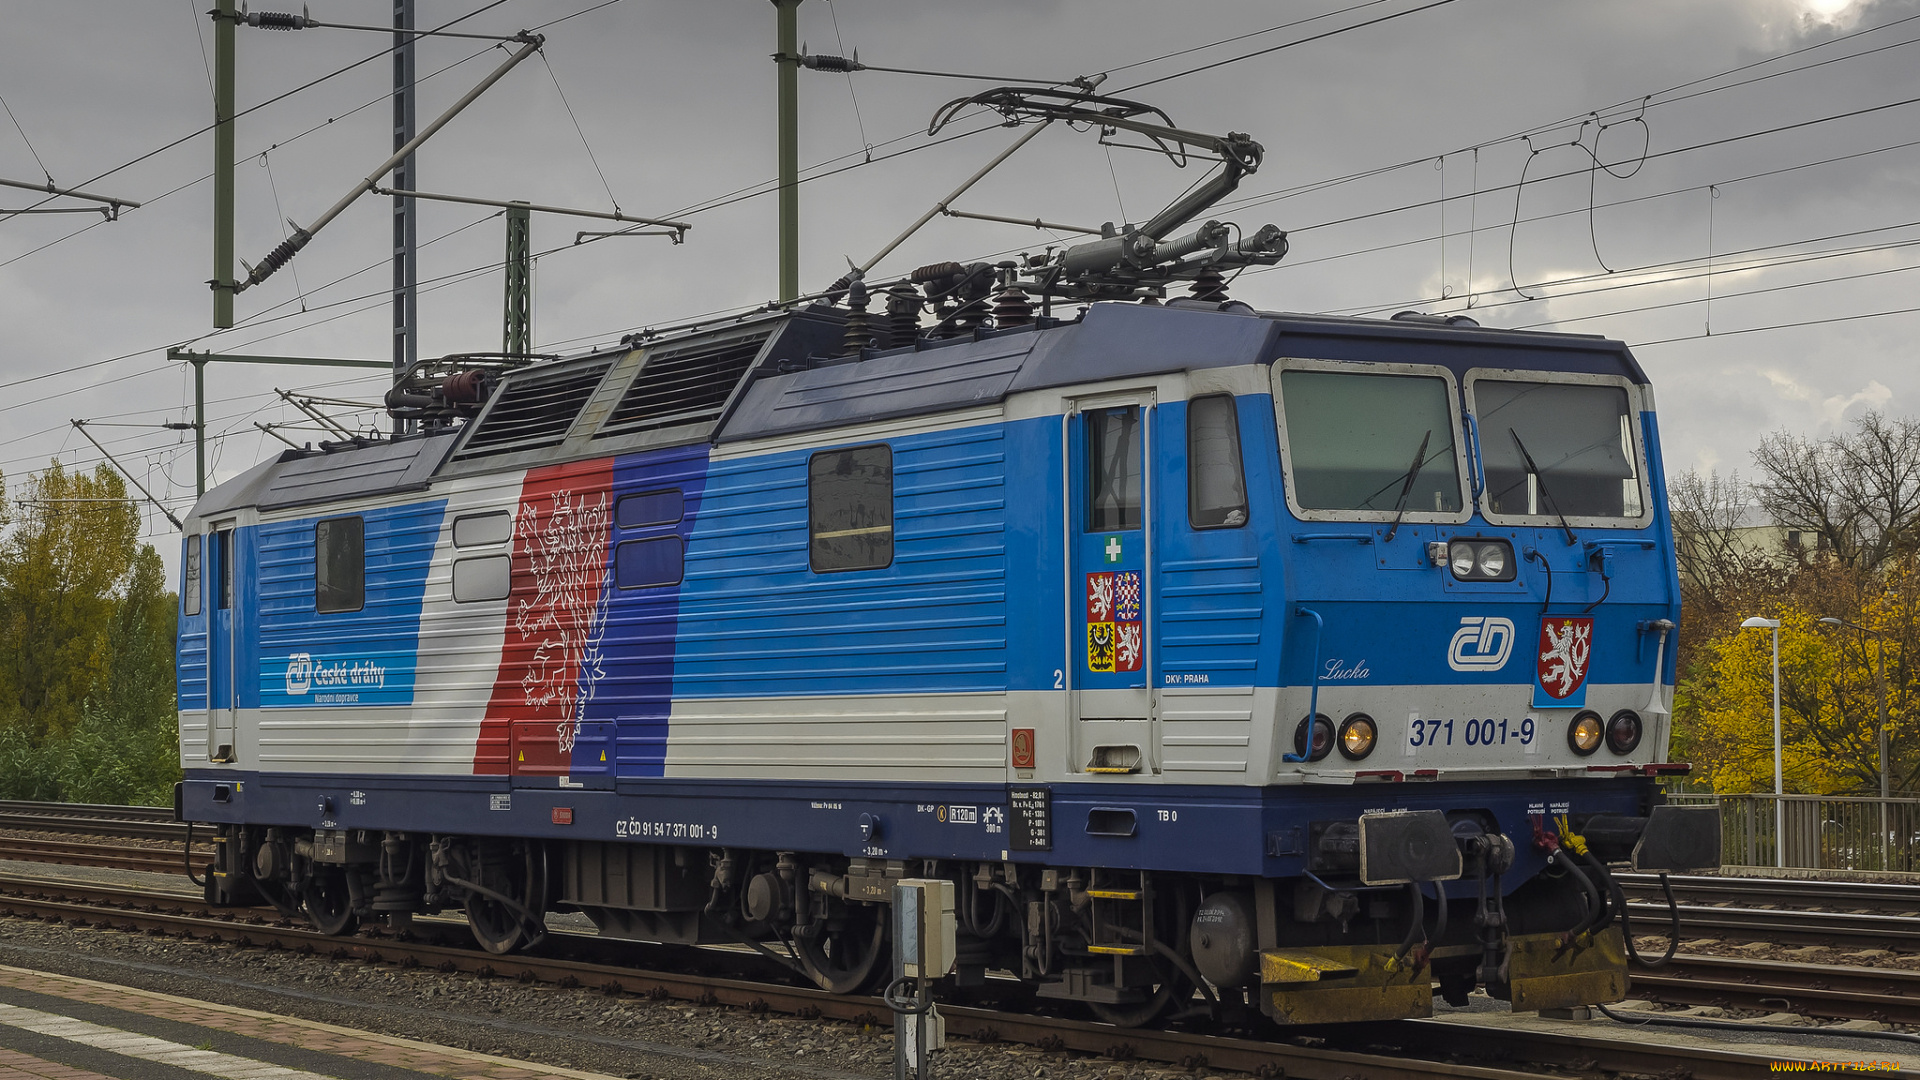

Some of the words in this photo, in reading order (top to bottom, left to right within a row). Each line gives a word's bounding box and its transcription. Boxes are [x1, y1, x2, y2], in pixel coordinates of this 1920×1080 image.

[313, 658, 348, 686] České
[349, 659, 386, 689] dráhy
[1053, 668, 1064, 690] 2
[1165, 674, 1183, 684] DKV:
[1183, 674, 1210, 684] PRAHA
[1318, 658, 1371, 681] Lucka
[1409, 718, 1455, 747] 371
[1465, 717, 1536, 747] 001-9
[917, 805, 935, 813] DK-GP
[1157, 810, 1170, 821] TB
[616, 820, 628, 838] CZ
[629, 816, 641, 835] ČD
[642, 821, 652, 836] 91
[654, 822, 664, 837] 54
[665, 822, 671, 837] 7
[673, 823, 687, 838] 371
[689, 823, 704, 839] 001
[711, 824, 718, 840] 9
[985, 824, 996, 833] 300
